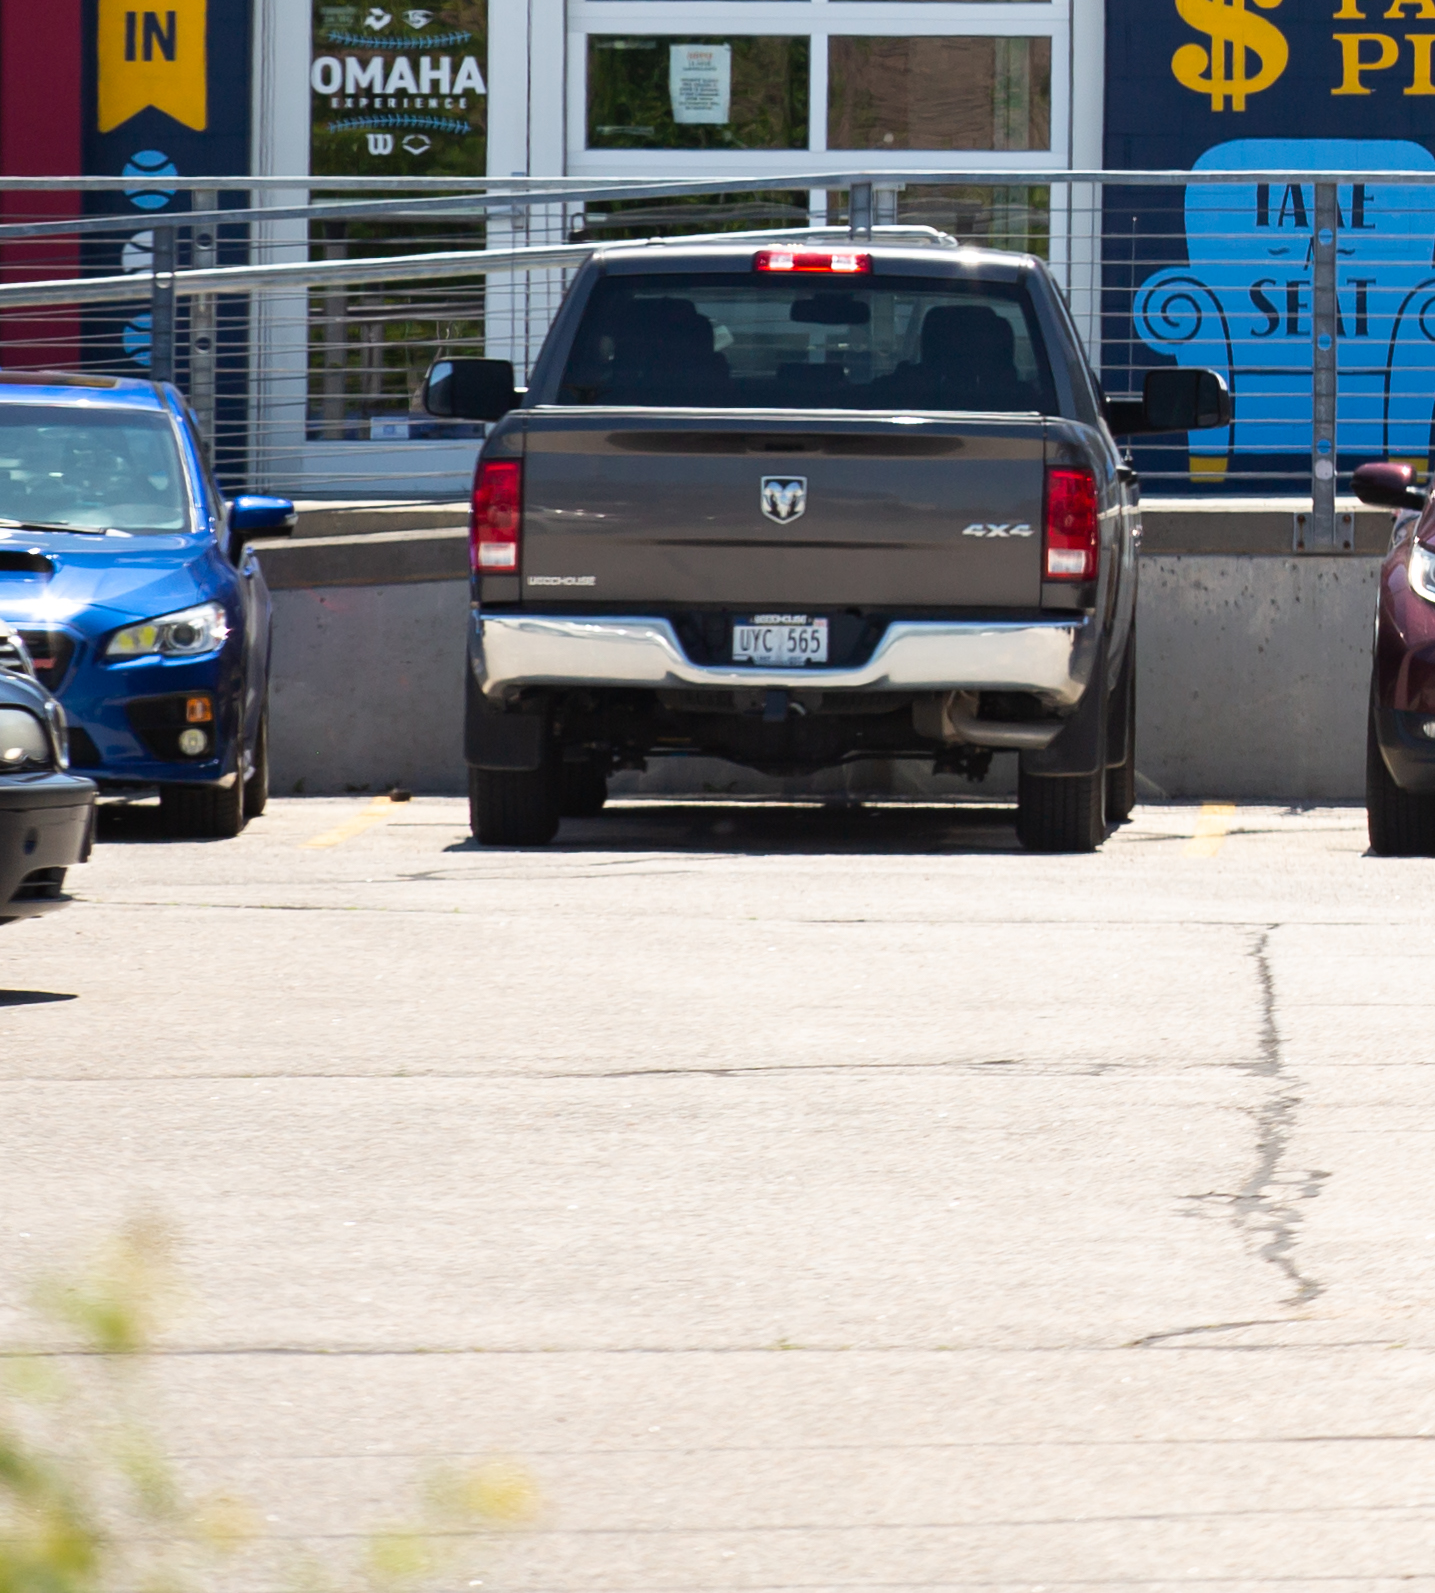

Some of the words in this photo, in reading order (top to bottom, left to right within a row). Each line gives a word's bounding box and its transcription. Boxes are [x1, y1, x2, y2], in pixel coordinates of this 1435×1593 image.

[124, 10, 177, 62] IN
[311, 56, 486, 95] OMAHA
[331, 97, 467, 109] EXPERIENCE
[1249, 278, 1376, 337] SET
[740, 628, 773, 653] UYC
[787, 627, 820, 653] 565
